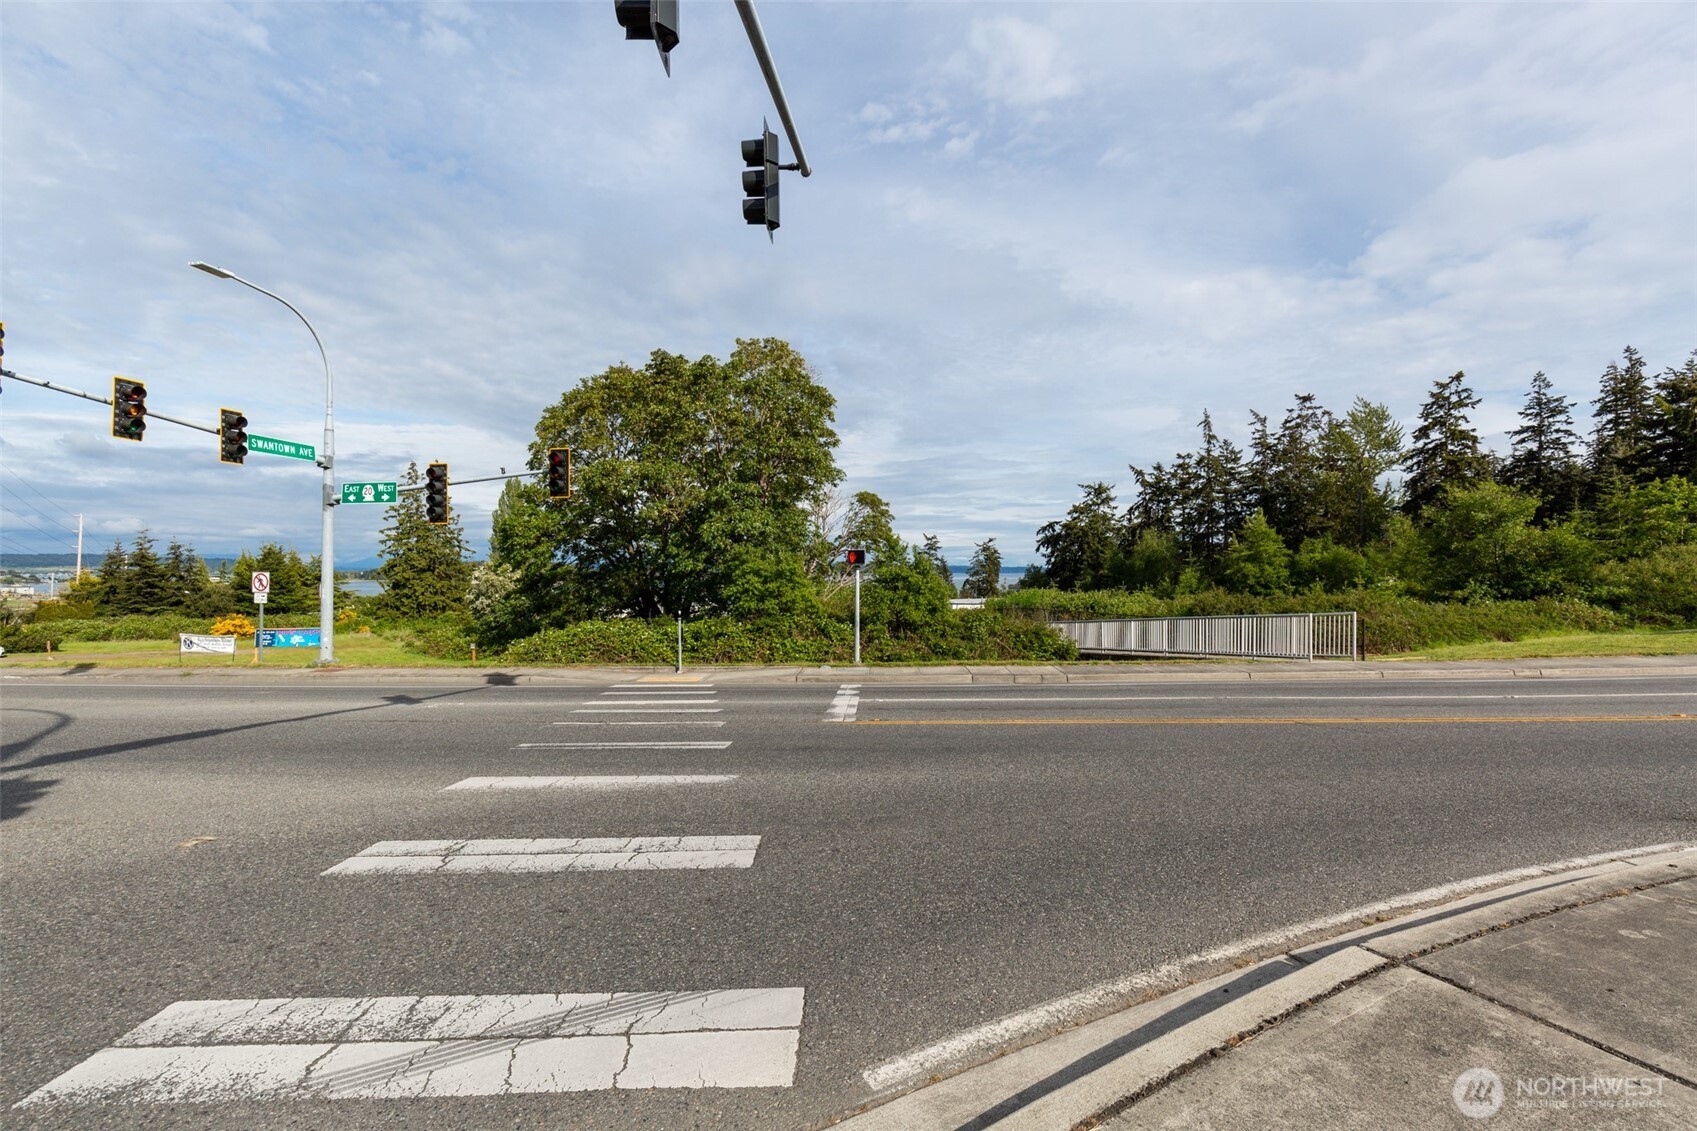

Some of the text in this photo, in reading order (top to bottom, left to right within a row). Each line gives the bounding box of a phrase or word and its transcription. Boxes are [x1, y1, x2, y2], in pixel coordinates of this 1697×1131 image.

[251, 438, 313, 458] SWANTOWN AVE
[363, 486, 373, 496] 20
